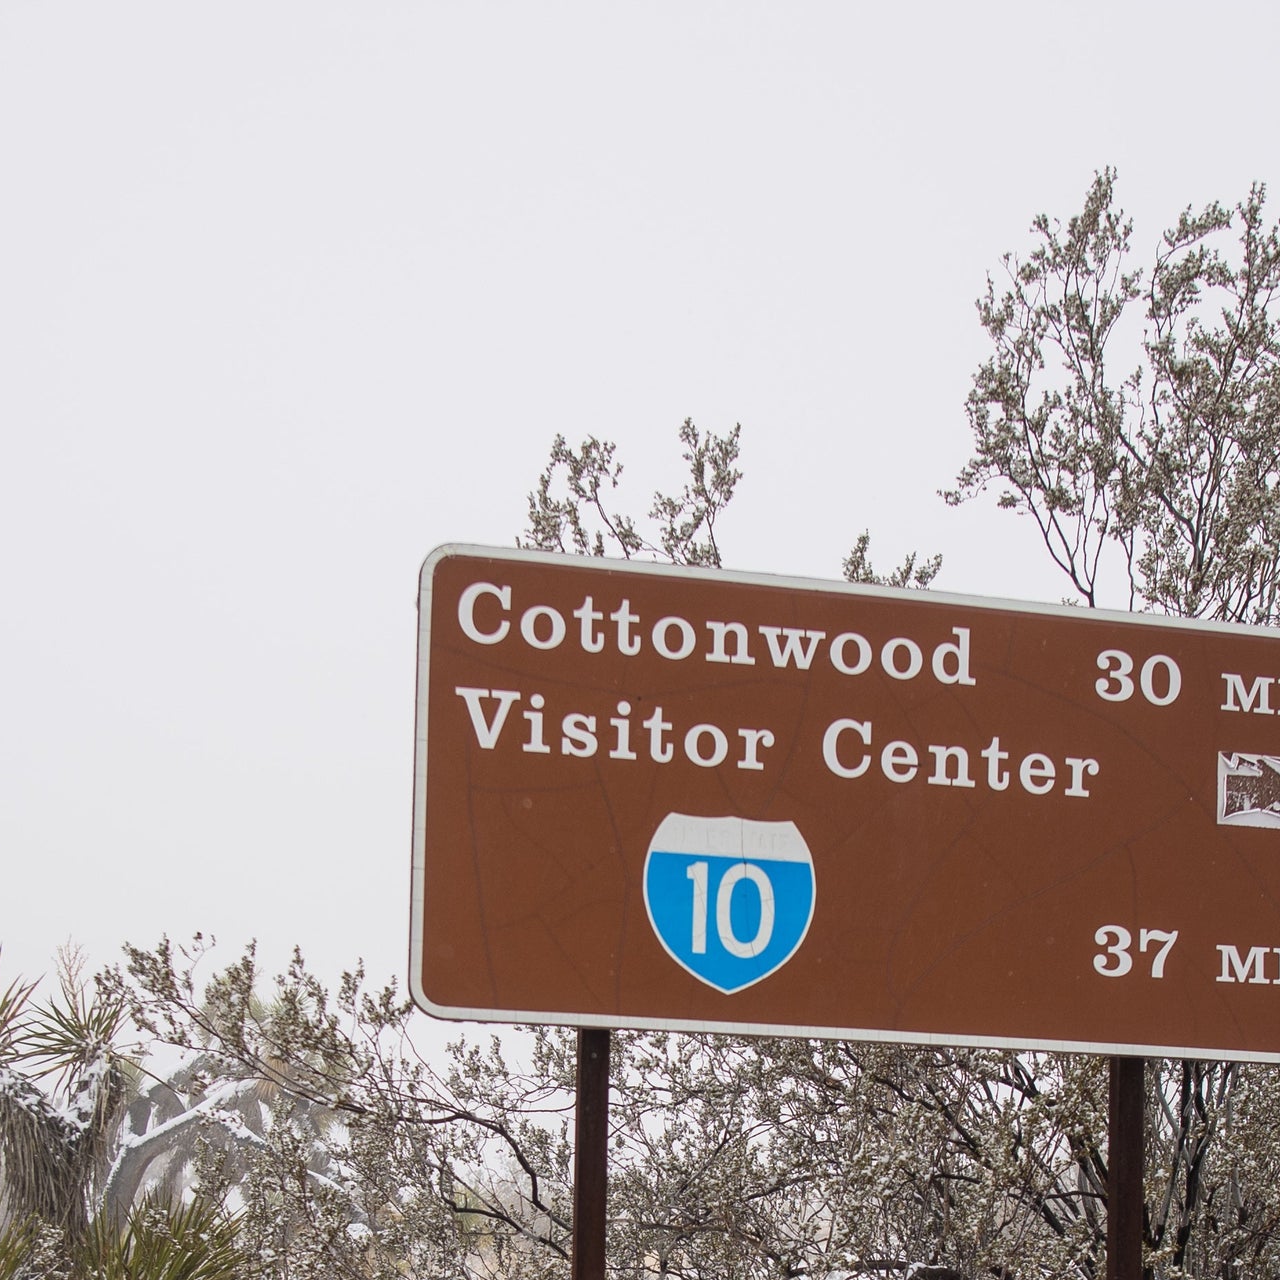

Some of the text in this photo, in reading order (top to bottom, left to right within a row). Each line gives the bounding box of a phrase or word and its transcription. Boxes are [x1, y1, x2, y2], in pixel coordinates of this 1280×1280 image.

[457, 582, 977, 686] Cottonwood
[1095, 649, 1182, 706] 30
[455, 686, 1100, 798] Visitor Center
[686, 861, 776, 959] 10
[1093, 924, 1179, 979] 37
